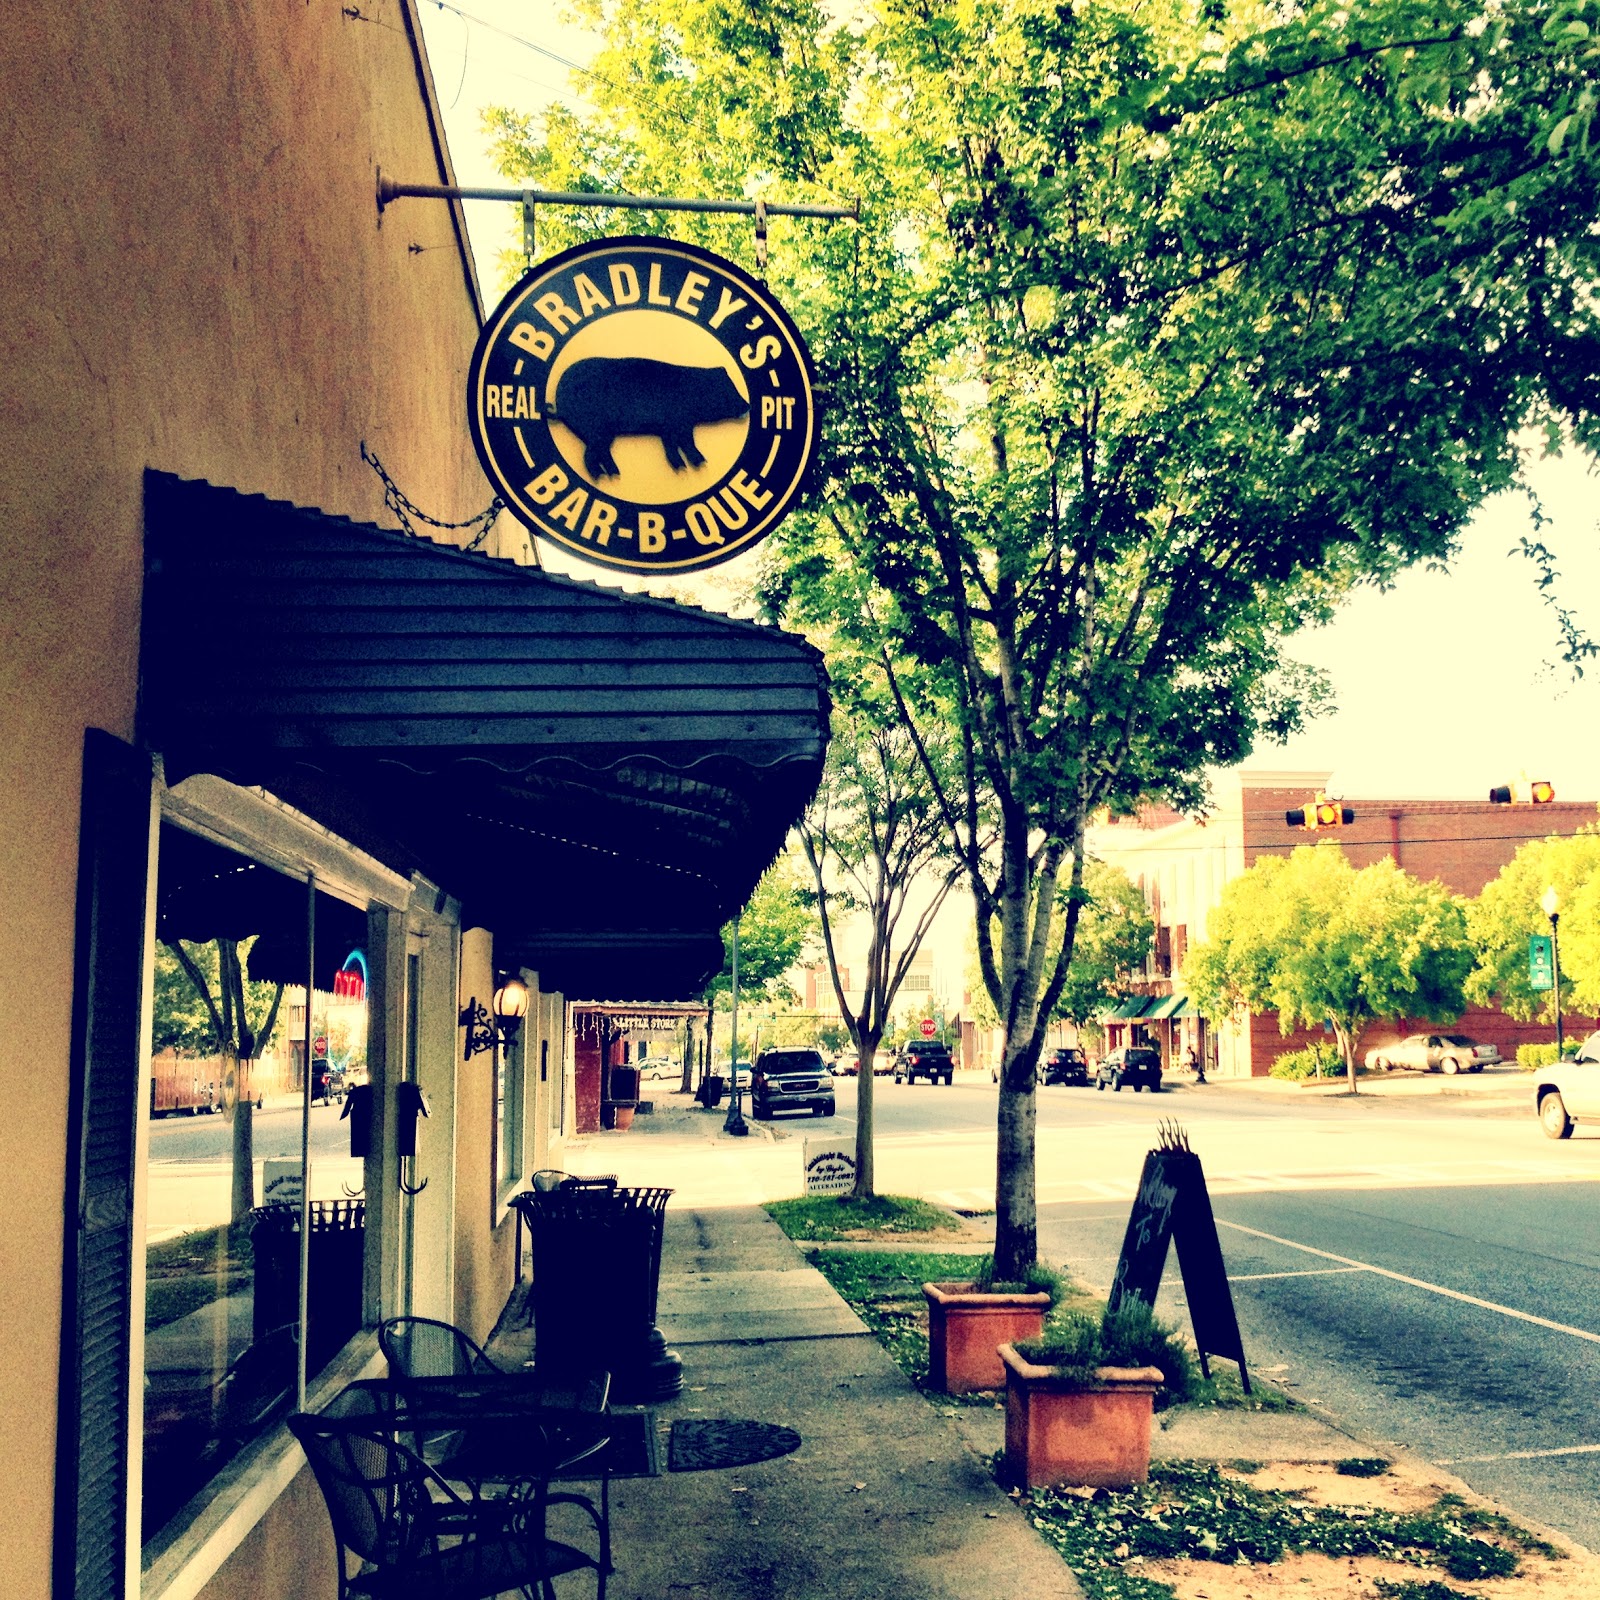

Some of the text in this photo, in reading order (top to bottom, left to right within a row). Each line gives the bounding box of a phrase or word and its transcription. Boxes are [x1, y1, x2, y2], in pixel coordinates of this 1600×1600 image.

[508, 262, 782, 369] BRADLEY'S
[486, 384, 541, 420] REAL
[761, 396, 796, 430] PIT
[523, 463, 774, 553] BAR-B-QUE
[651, 1018, 676, 1029] STORE
[920, 1023, 936, 1031] STOP
